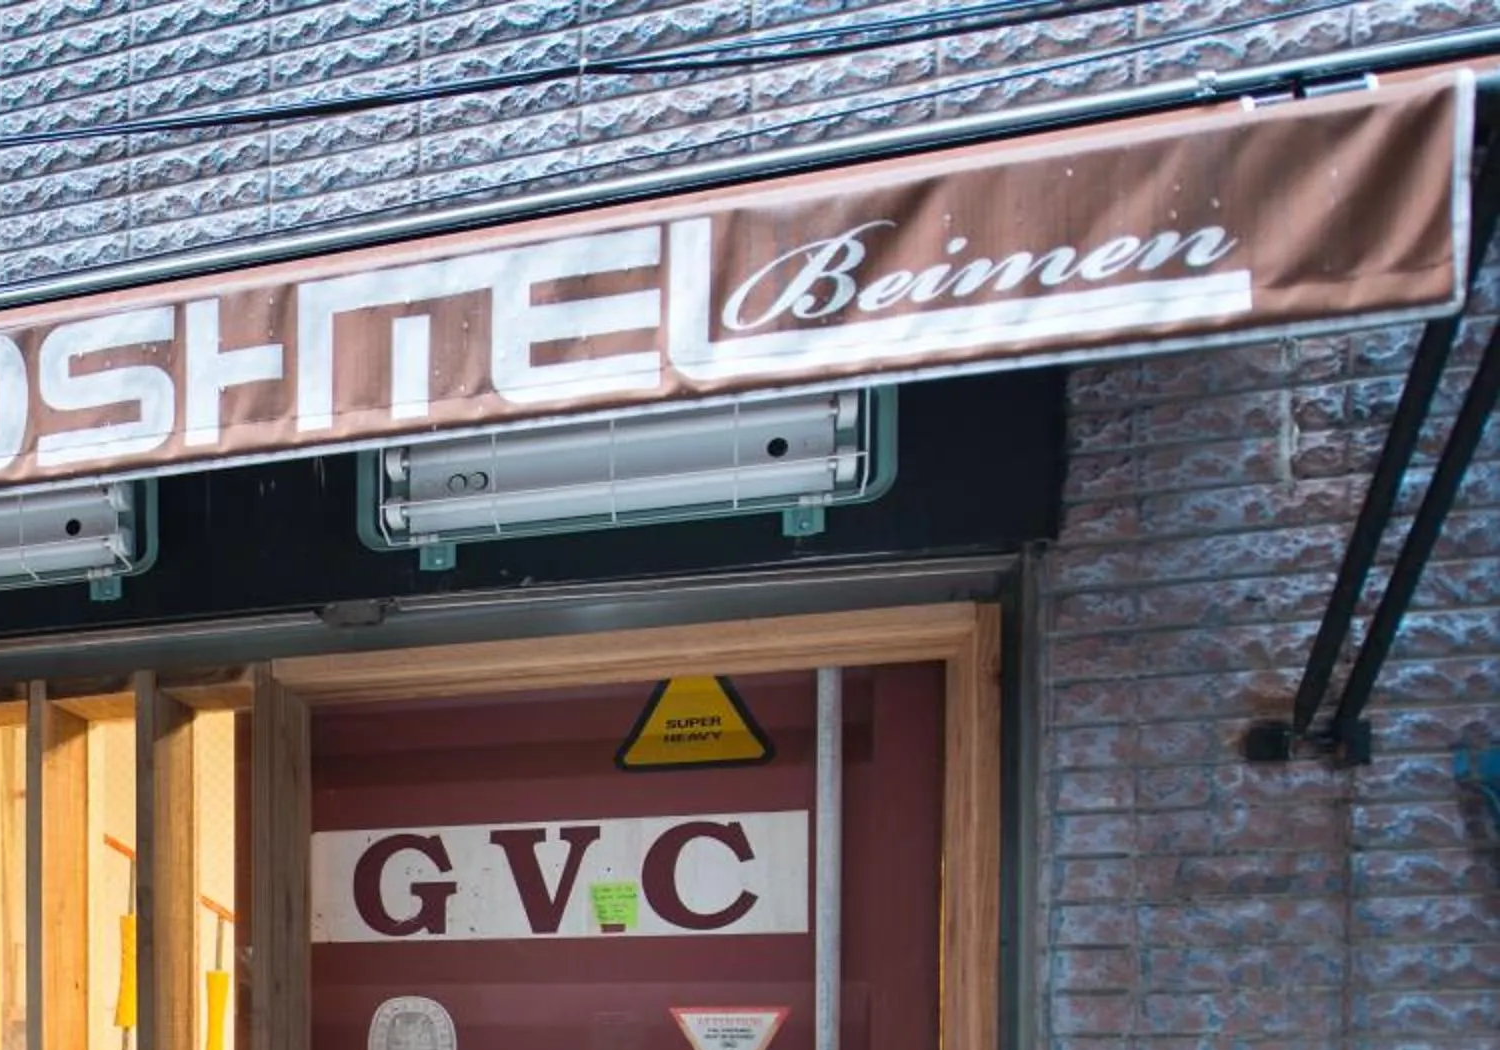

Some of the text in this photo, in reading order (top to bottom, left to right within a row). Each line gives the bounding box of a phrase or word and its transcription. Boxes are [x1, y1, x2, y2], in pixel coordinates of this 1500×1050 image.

[721, 220, 1238, 331] Beimen
[665, 716, 722, 730] SUPER
[663, 731, 723, 744] HEAVY
